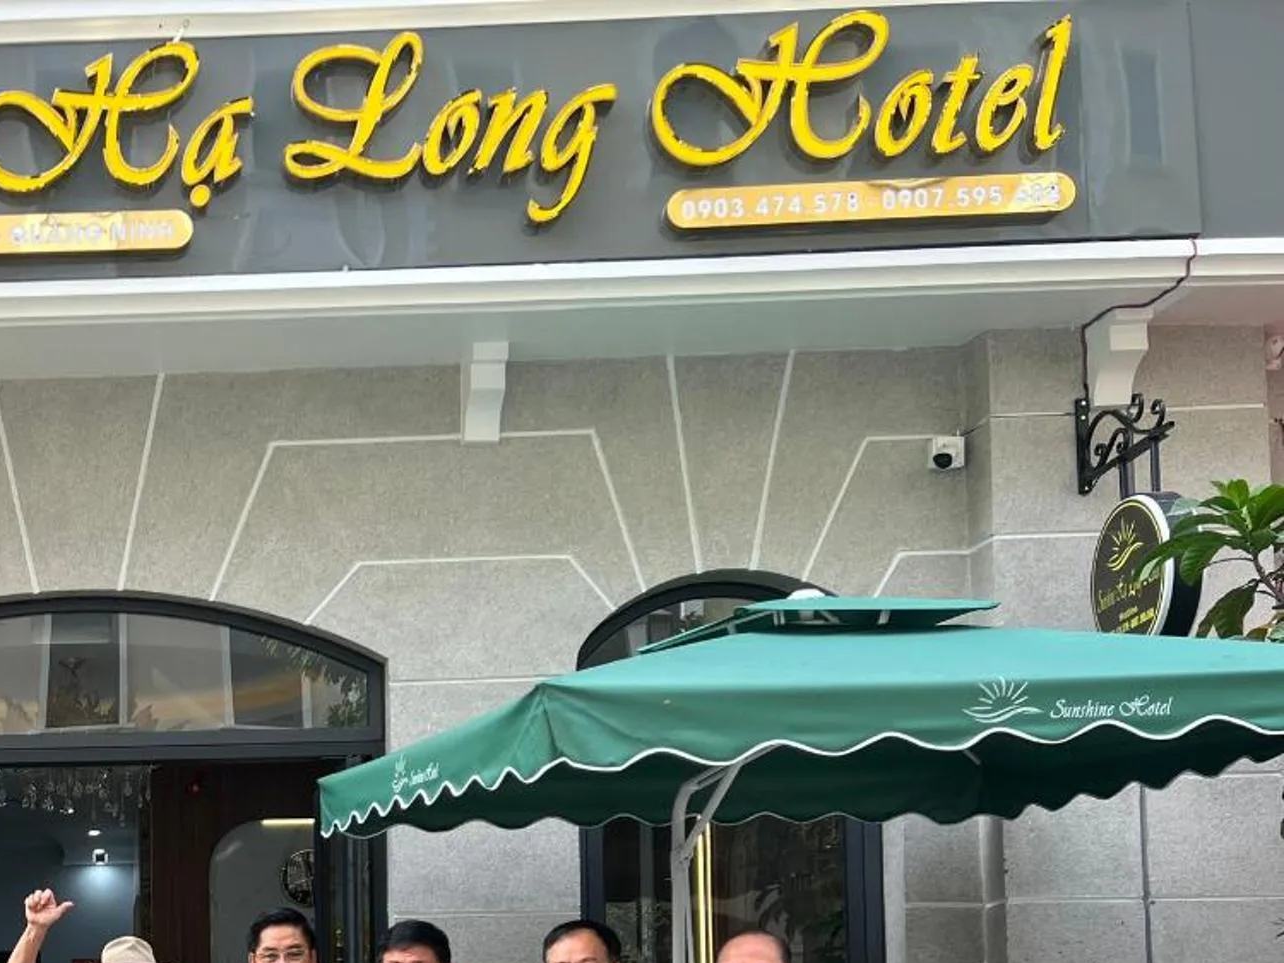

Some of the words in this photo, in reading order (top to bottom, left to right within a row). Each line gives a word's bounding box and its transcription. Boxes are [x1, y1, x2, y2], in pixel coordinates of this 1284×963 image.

[284, 31, 618, 223] Long
[652, 10, 1073, 166] Hotel
[1050, 698, 1115, 720] Sunshine
[1118, 694, 1174, 717] Hotel
